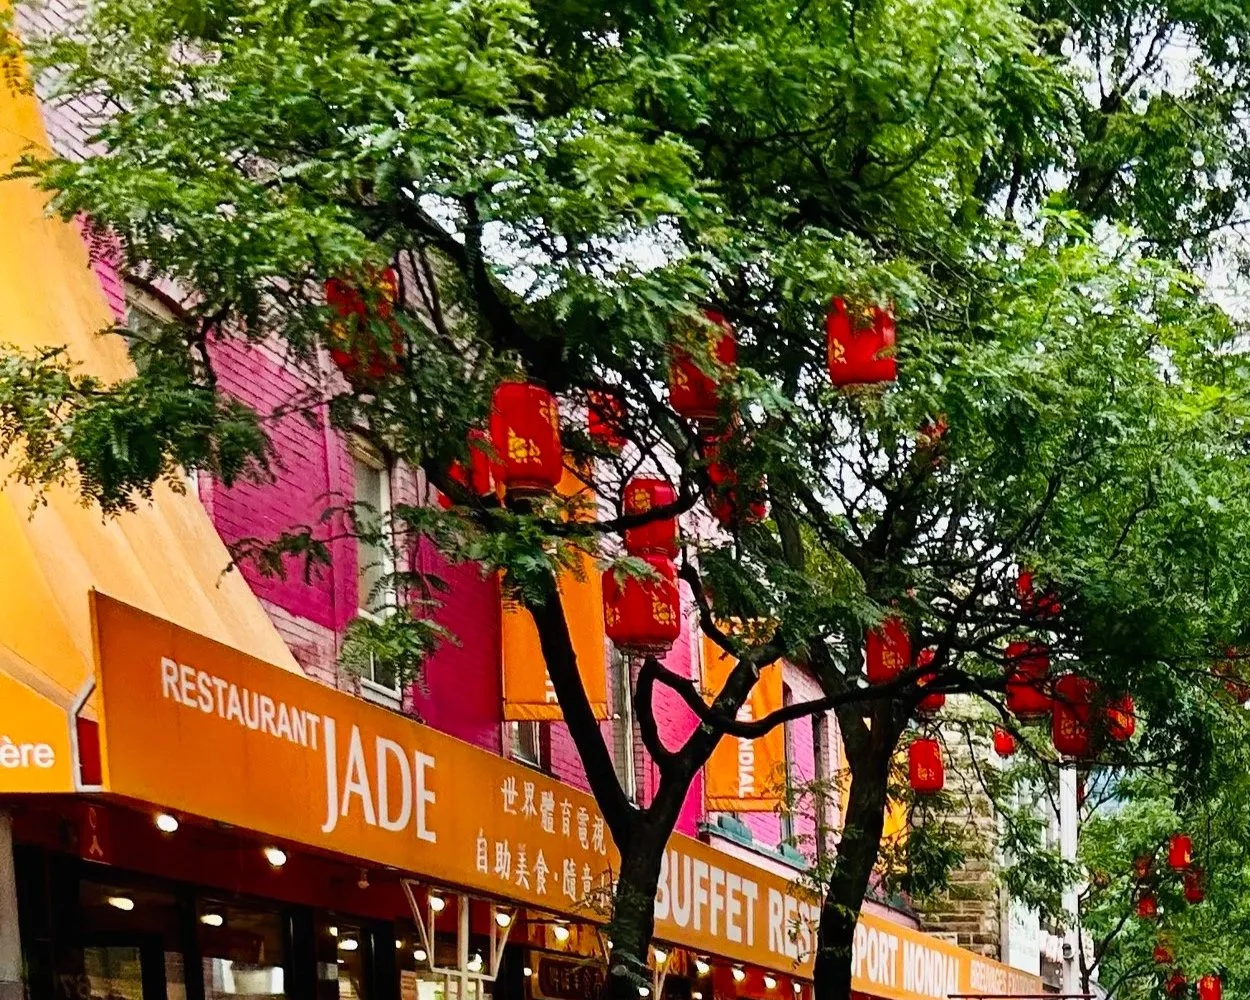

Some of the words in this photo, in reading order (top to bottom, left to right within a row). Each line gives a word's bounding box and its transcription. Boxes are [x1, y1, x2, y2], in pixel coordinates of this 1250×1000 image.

[160, 656, 320, 750] RESTAURANT
[321, 715, 437, 844] JADE
[654, 849, 758, 947] BUFFET
